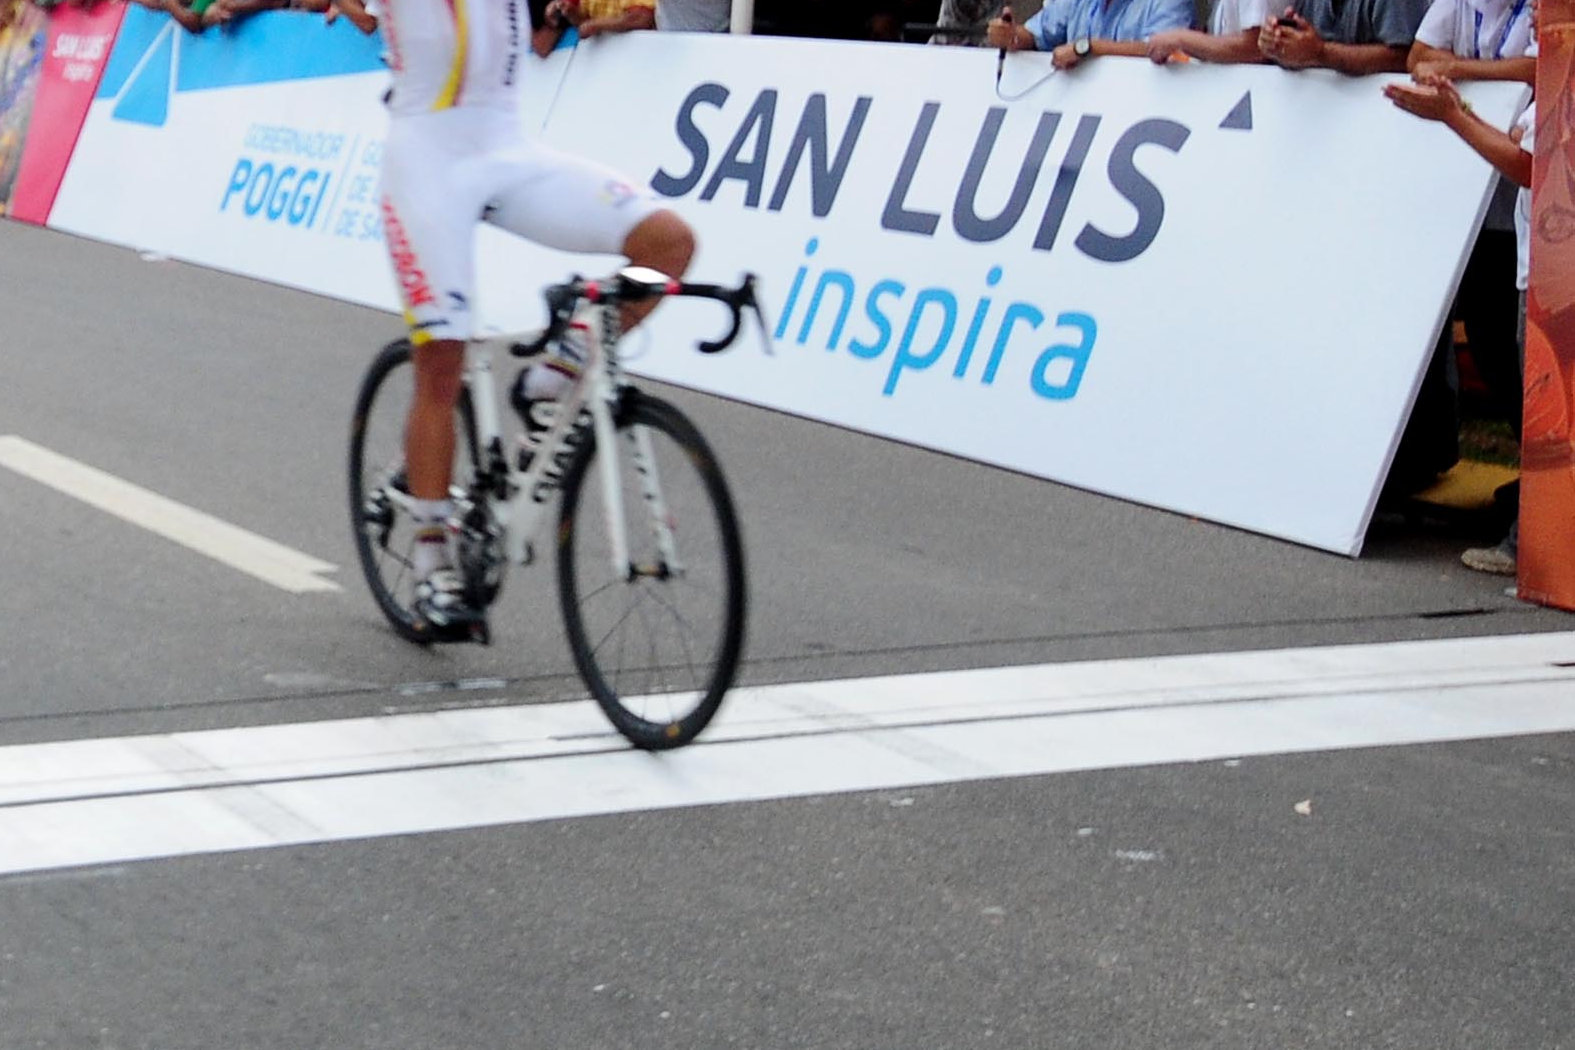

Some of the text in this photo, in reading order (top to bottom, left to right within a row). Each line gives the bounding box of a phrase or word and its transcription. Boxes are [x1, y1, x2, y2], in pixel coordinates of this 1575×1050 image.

[220, 158, 332, 229] POGGI
[650, 82, 1192, 264] SAN LUIS
[774, 238, 1098, 402] inspira
